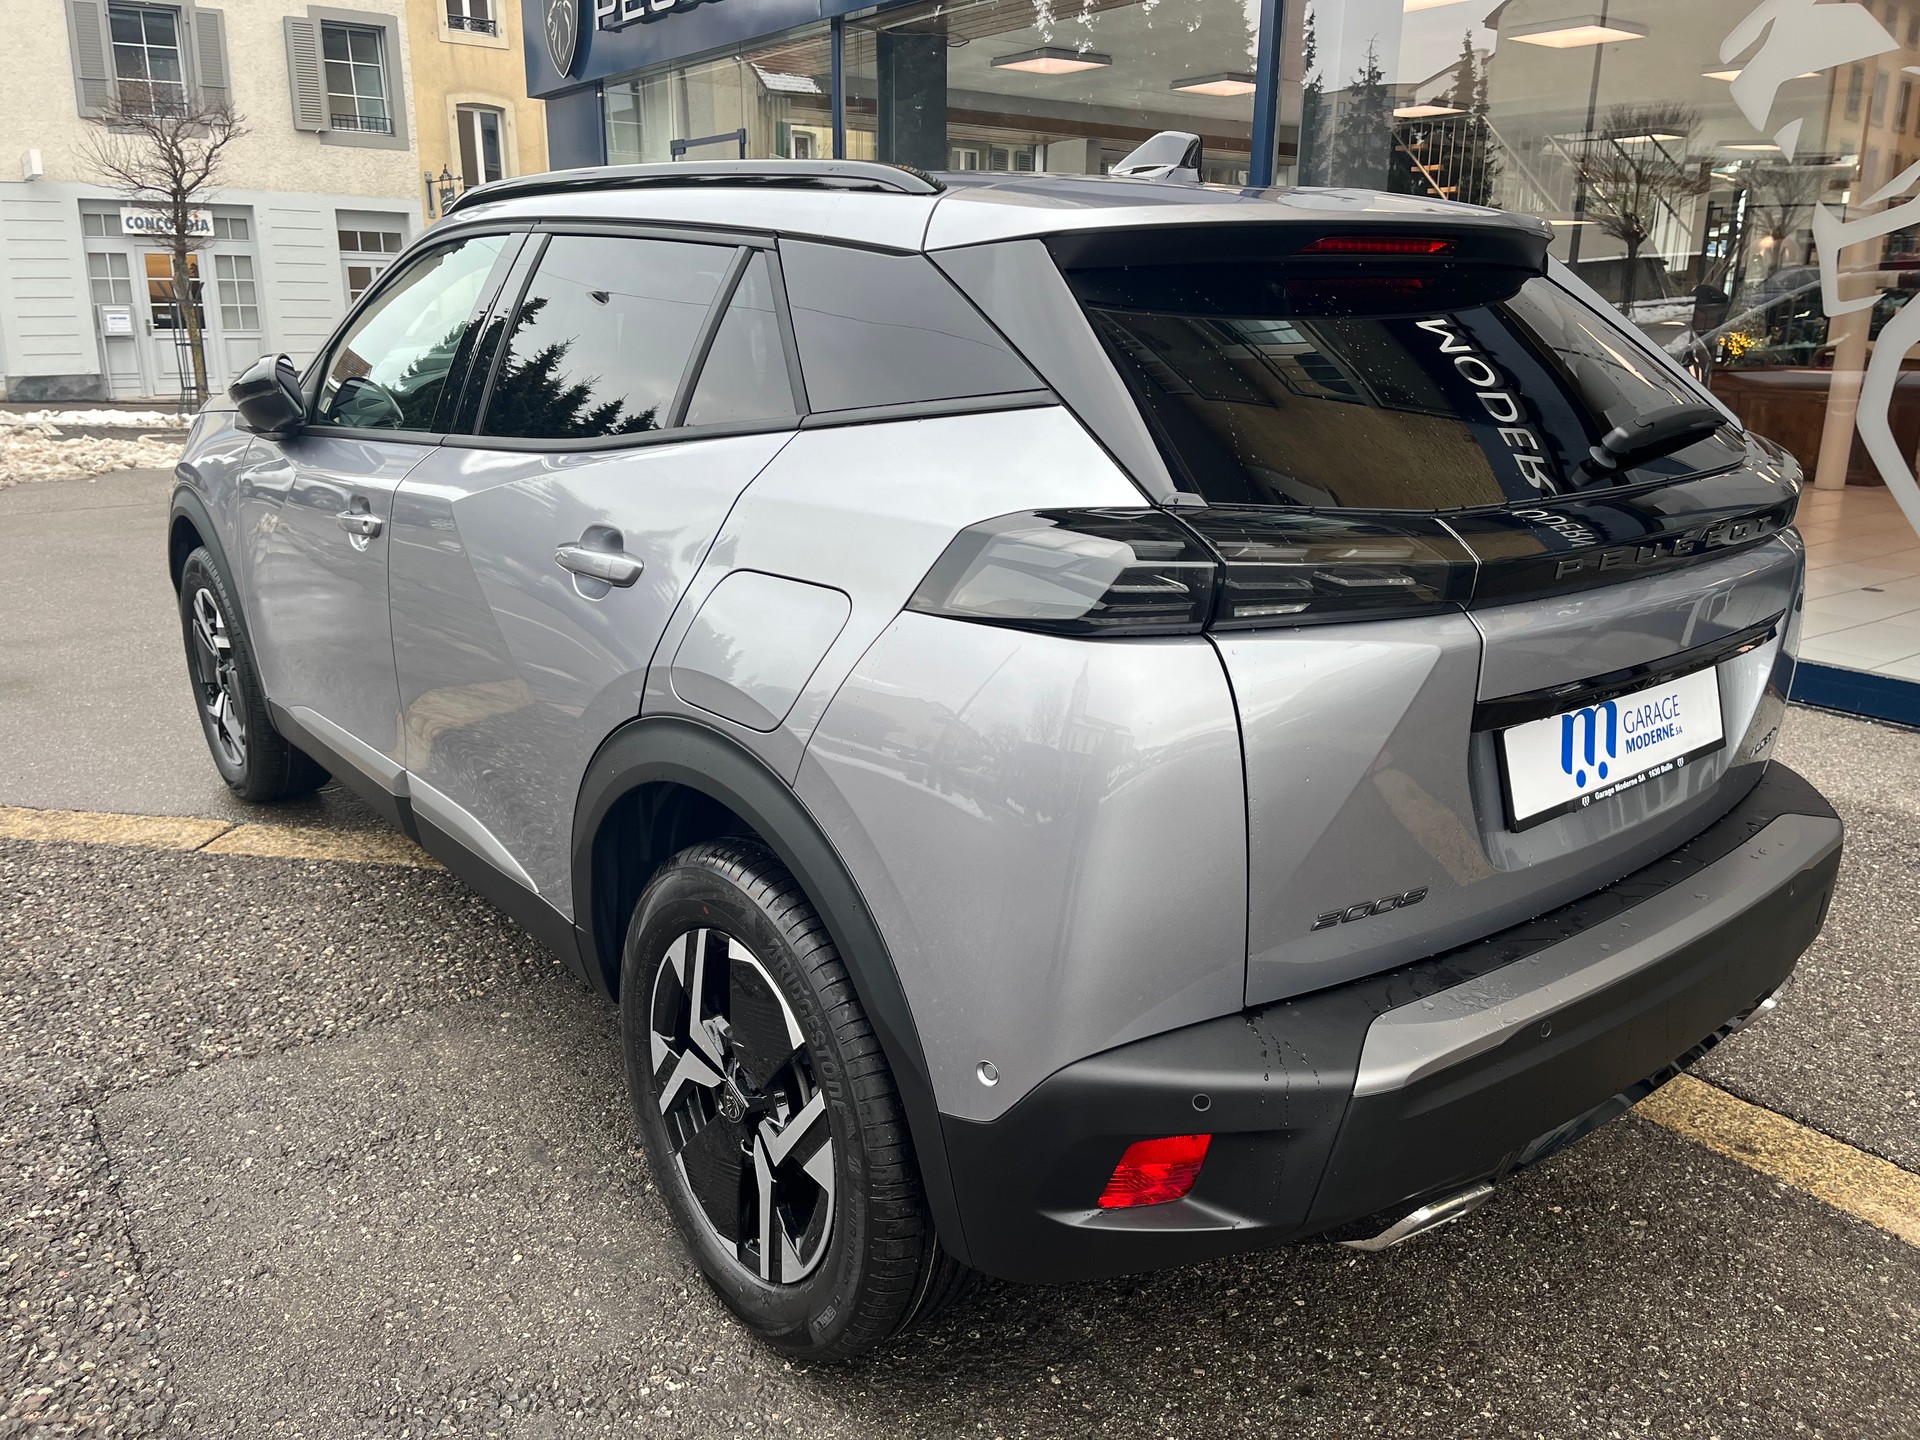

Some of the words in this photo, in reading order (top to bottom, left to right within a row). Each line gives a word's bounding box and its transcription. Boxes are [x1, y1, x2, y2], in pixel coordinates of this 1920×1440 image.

[125, 216, 210, 232] CONCODIA
[1554, 515, 1772, 580] PEUGEOT
[1623, 694, 1681, 734] GARAGE
[1625, 722, 1675, 754] MODERNE
[1675, 725, 1683, 736] SA
[1595, 788, 1615, 800] Garage
[1615, 776, 1638, 792] Moderne
[1638, 773, 1646, 783] SA
[1310, 886, 1428, 932] 2008
[764, 937, 847, 1117] BRIDGESTONE
